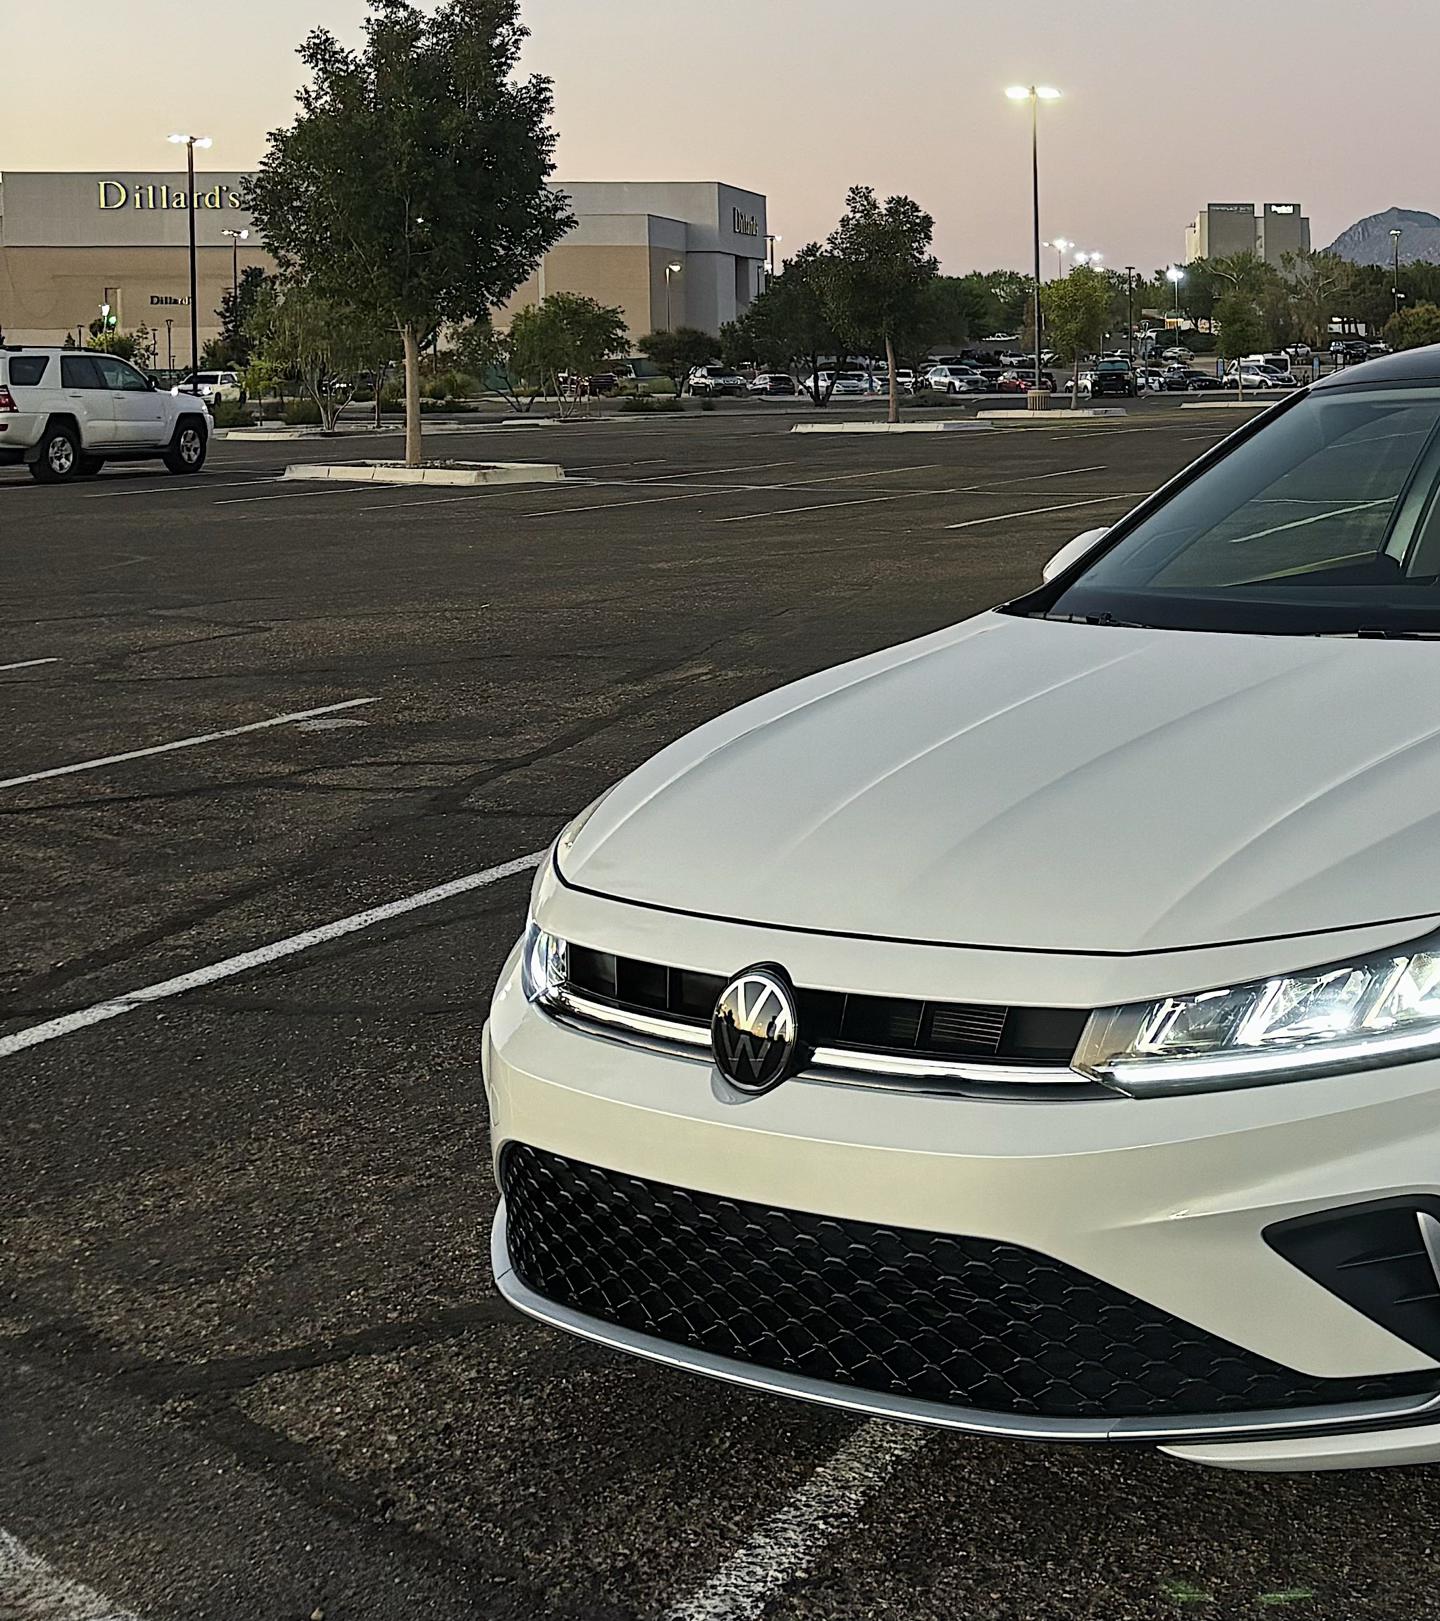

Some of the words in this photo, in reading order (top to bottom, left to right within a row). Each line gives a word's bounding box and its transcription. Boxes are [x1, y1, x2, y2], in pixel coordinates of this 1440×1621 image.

[98, 181, 241, 209] Dillard's
[150, 295, 191, 305] Dillard
[713, 975, 795, 1091] VW
